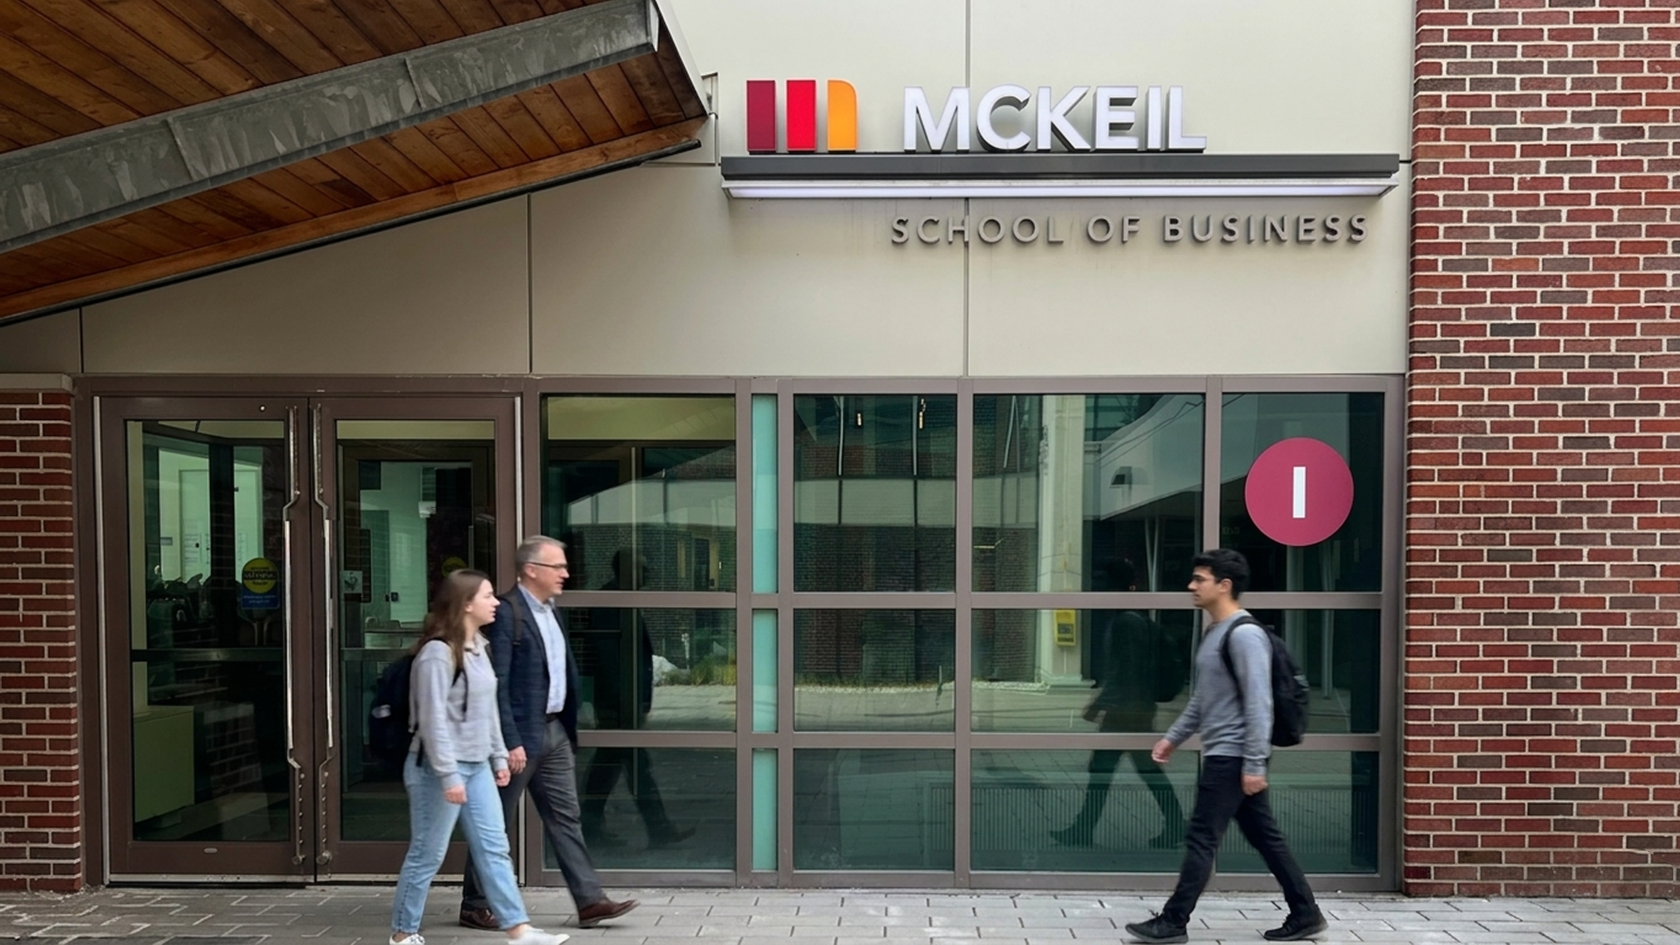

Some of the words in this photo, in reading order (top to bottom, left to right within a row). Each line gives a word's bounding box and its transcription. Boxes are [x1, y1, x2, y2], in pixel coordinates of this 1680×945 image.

[903, 84, 1207, 152] MCKEIL
[892, 215, 1064, 244] SCHOOL
[1087, 215, 1140, 244] OF
[1163, 214, 1369, 243] BUSINESS
